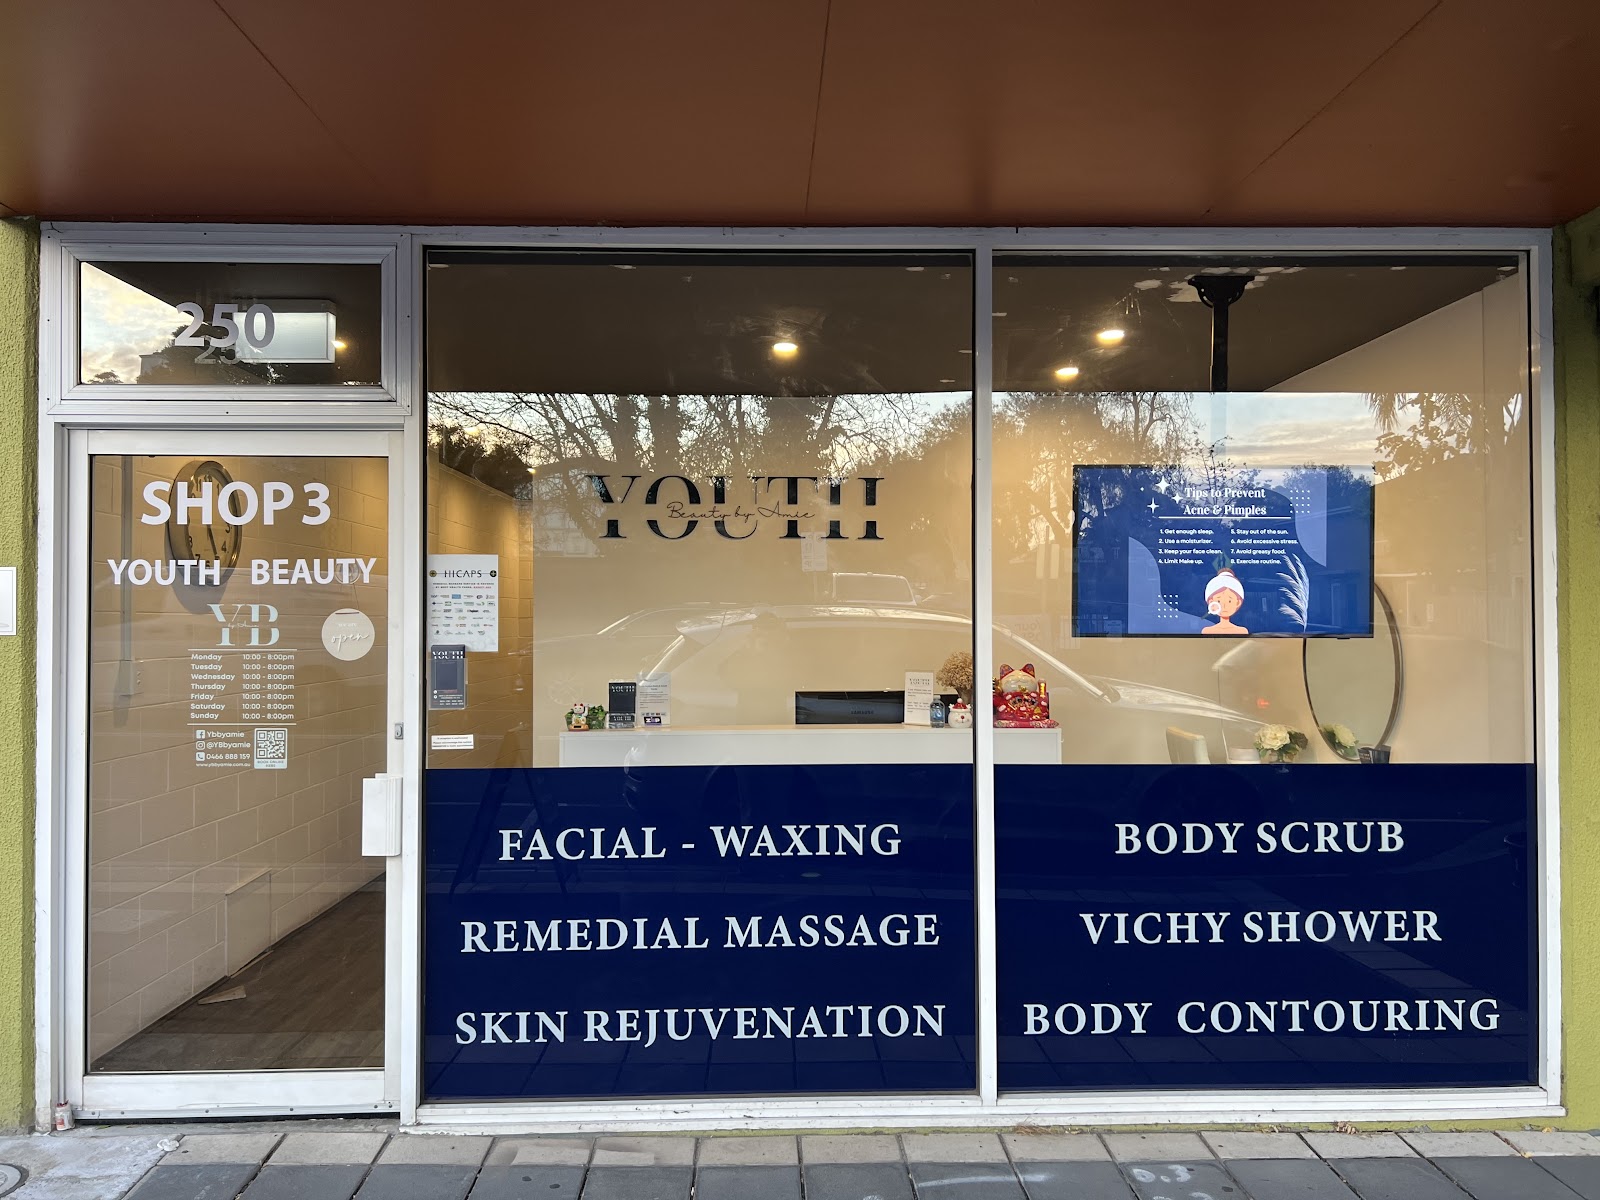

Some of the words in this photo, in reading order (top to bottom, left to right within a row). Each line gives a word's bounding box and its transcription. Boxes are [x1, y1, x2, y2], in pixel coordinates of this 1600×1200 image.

[174, 301, 276, 349] 250
[140, 480, 295, 526] SHOP
[302, 481, 331, 526] 3
[1184, 487, 1208, 499] Tips
[1210, 488, 1222, 498] to
[1224, 487, 1266, 498] Prevent
[585, 474, 885, 540] YOUTH
[666, 501, 731, 521] Beauty
[734, 503, 756, 523] by
[757, 500, 816, 520] Amie
[1183, 504, 1210, 515] Acne
[1212, 504, 1222, 515] &
[1224, 504, 1267, 517] Pimples
[107, 558, 221, 586] YOUTH
[250, 557, 377, 585] BEAUTY
[444, 569, 483, 578] HICAPS
[206, 603, 280, 646] YB
[331, 630, 369, 653] open
[267, 683, 295, 691] 8:00pm
[267, 693, 295, 701] 8:00pm
[190, 712, 219, 720] Sunday
[267, 713, 295, 721] 8:00pm
[267, 703, 295, 711] 8:00pm
[206, 742, 251, 750] @YBbyamie
[207, 730, 245, 738] Ybbyamie
[498, 826, 667, 862] FACIAL
[710, 822, 902, 858] WAXING
[1115, 821, 1244, 855] BODY
[1256, 820, 1405, 854] SCRUB
[460, 916, 709, 953] REMEDIAL
[723, 913, 940, 949] MASSAGE
[1079, 911, 1231, 945] VICHY
[1242, 909, 1442, 944] SHOWER
[455, 1010, 568, 1045] SKIN
[583, 1004, 946, 1048] REJUVENATION
[1023, 1002, 1153, 1036] BODY
[1177, 998, 1500, 1034] CONTOURING
